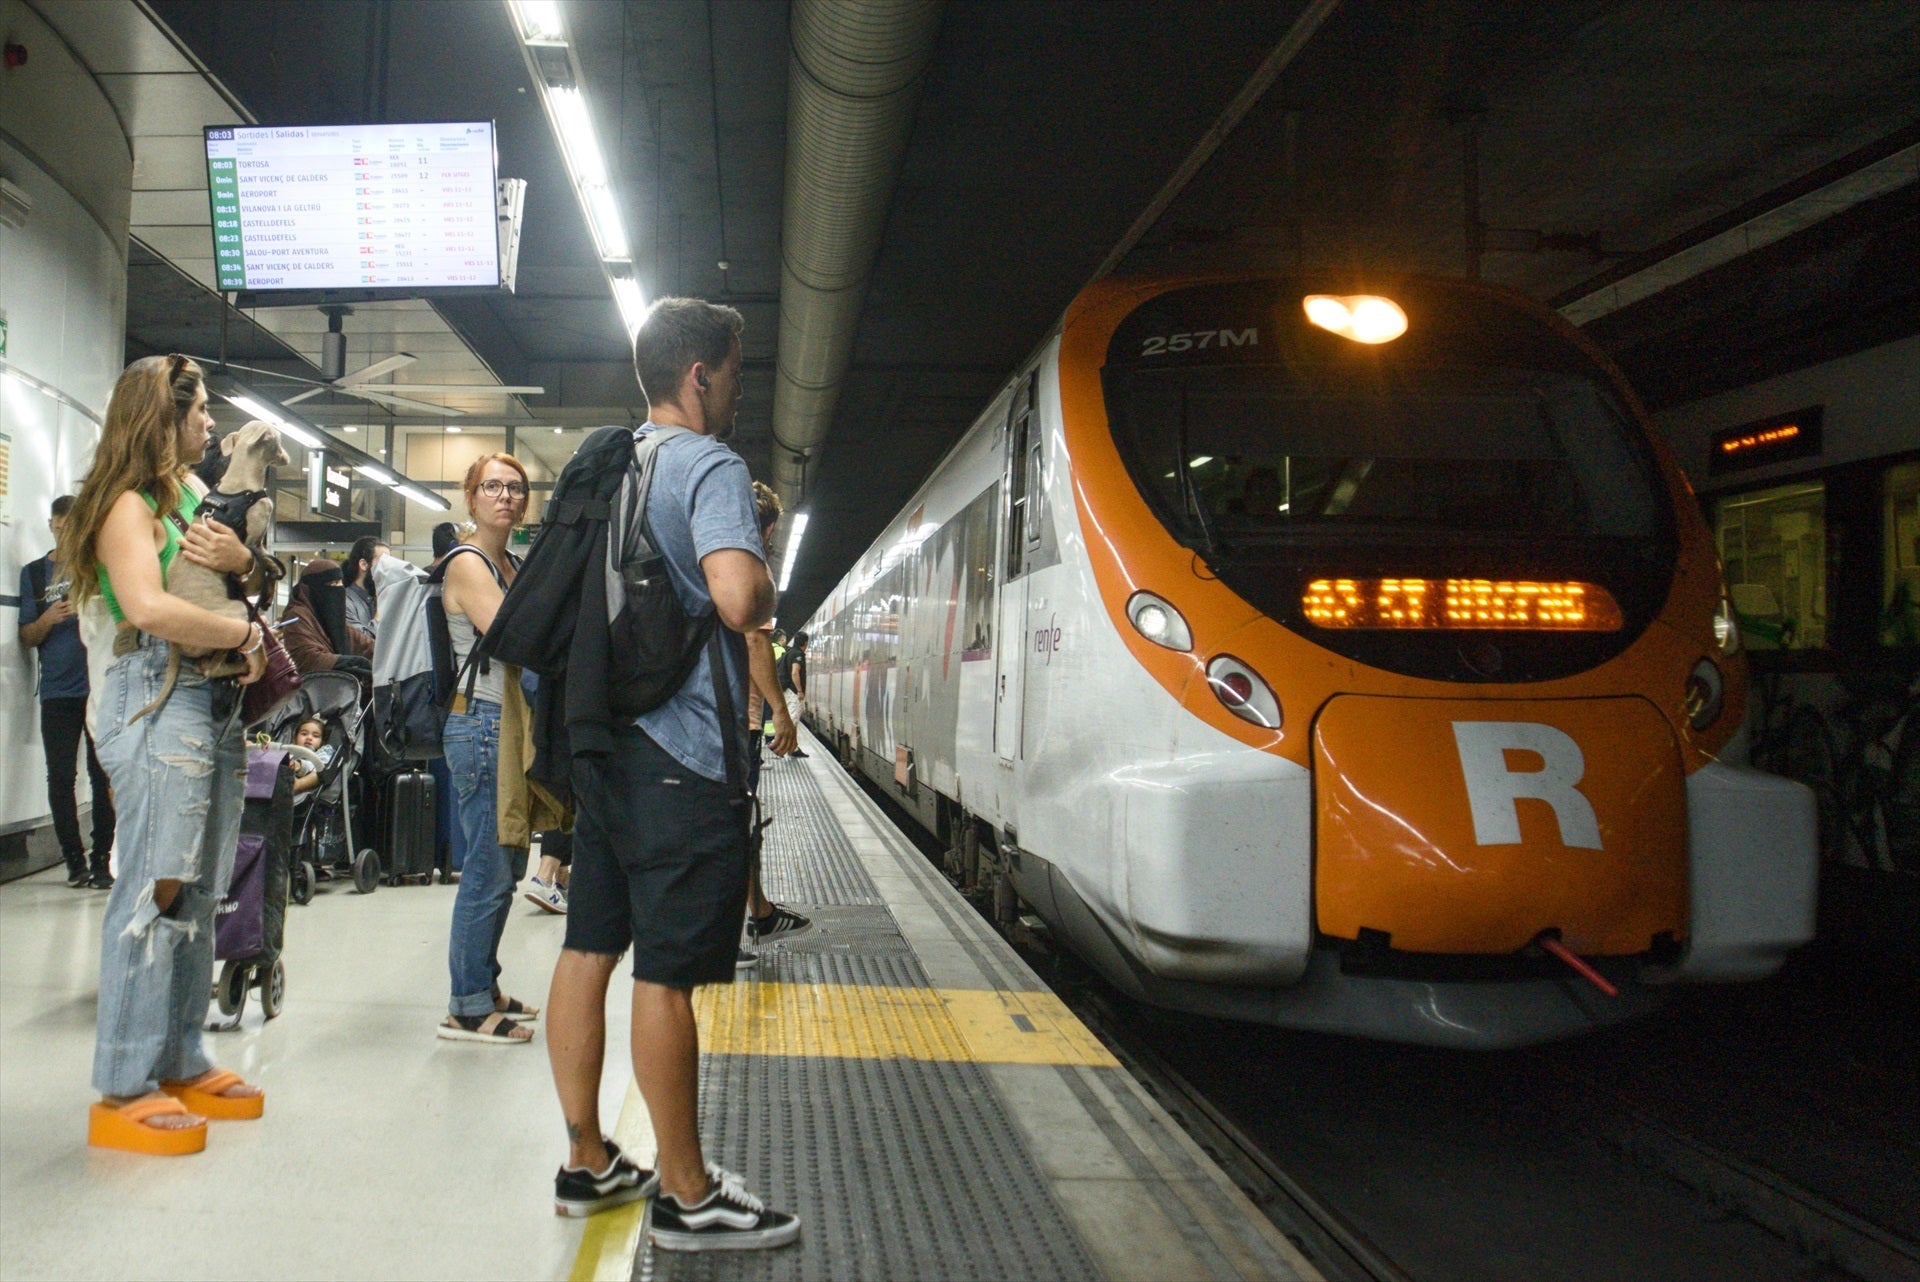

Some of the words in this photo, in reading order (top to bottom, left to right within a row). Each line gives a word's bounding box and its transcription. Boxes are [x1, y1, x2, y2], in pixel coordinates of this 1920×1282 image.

[209, 131, 232, 140] 08:03
[238, 131, 269, 139] Sortides
[275, 130, 304, 138] Salidas
[238, 160, 270, 168] TORTOSA
[260, 175, 284, 184] VICENÇ
[286, 175, 295, 183] DE
[297, 174, 329, 182] CALDERS
[419, 171, 429, 179] 12
[241, 190, 277, 198] AEROPORT
[241, 205, 276, 213] VILANOVA
[244, 234, 297, 242] CASTELLDEFELS
[245, 248, 290, 256] SALOU-PORT
[292, 248, 329, 256] AVENTURA
[266, 263, 290, 272] VICENÇ
[292, 262, 302, 270] DE
[304, 262, 335, 270] CALDERS
[247, 277, 284, 285] AEROPORT
[1141, 327, 1259, 357] 257M
[1034, 612, 1062, 666] renfe
[1451, 721, 1604, 850] R
